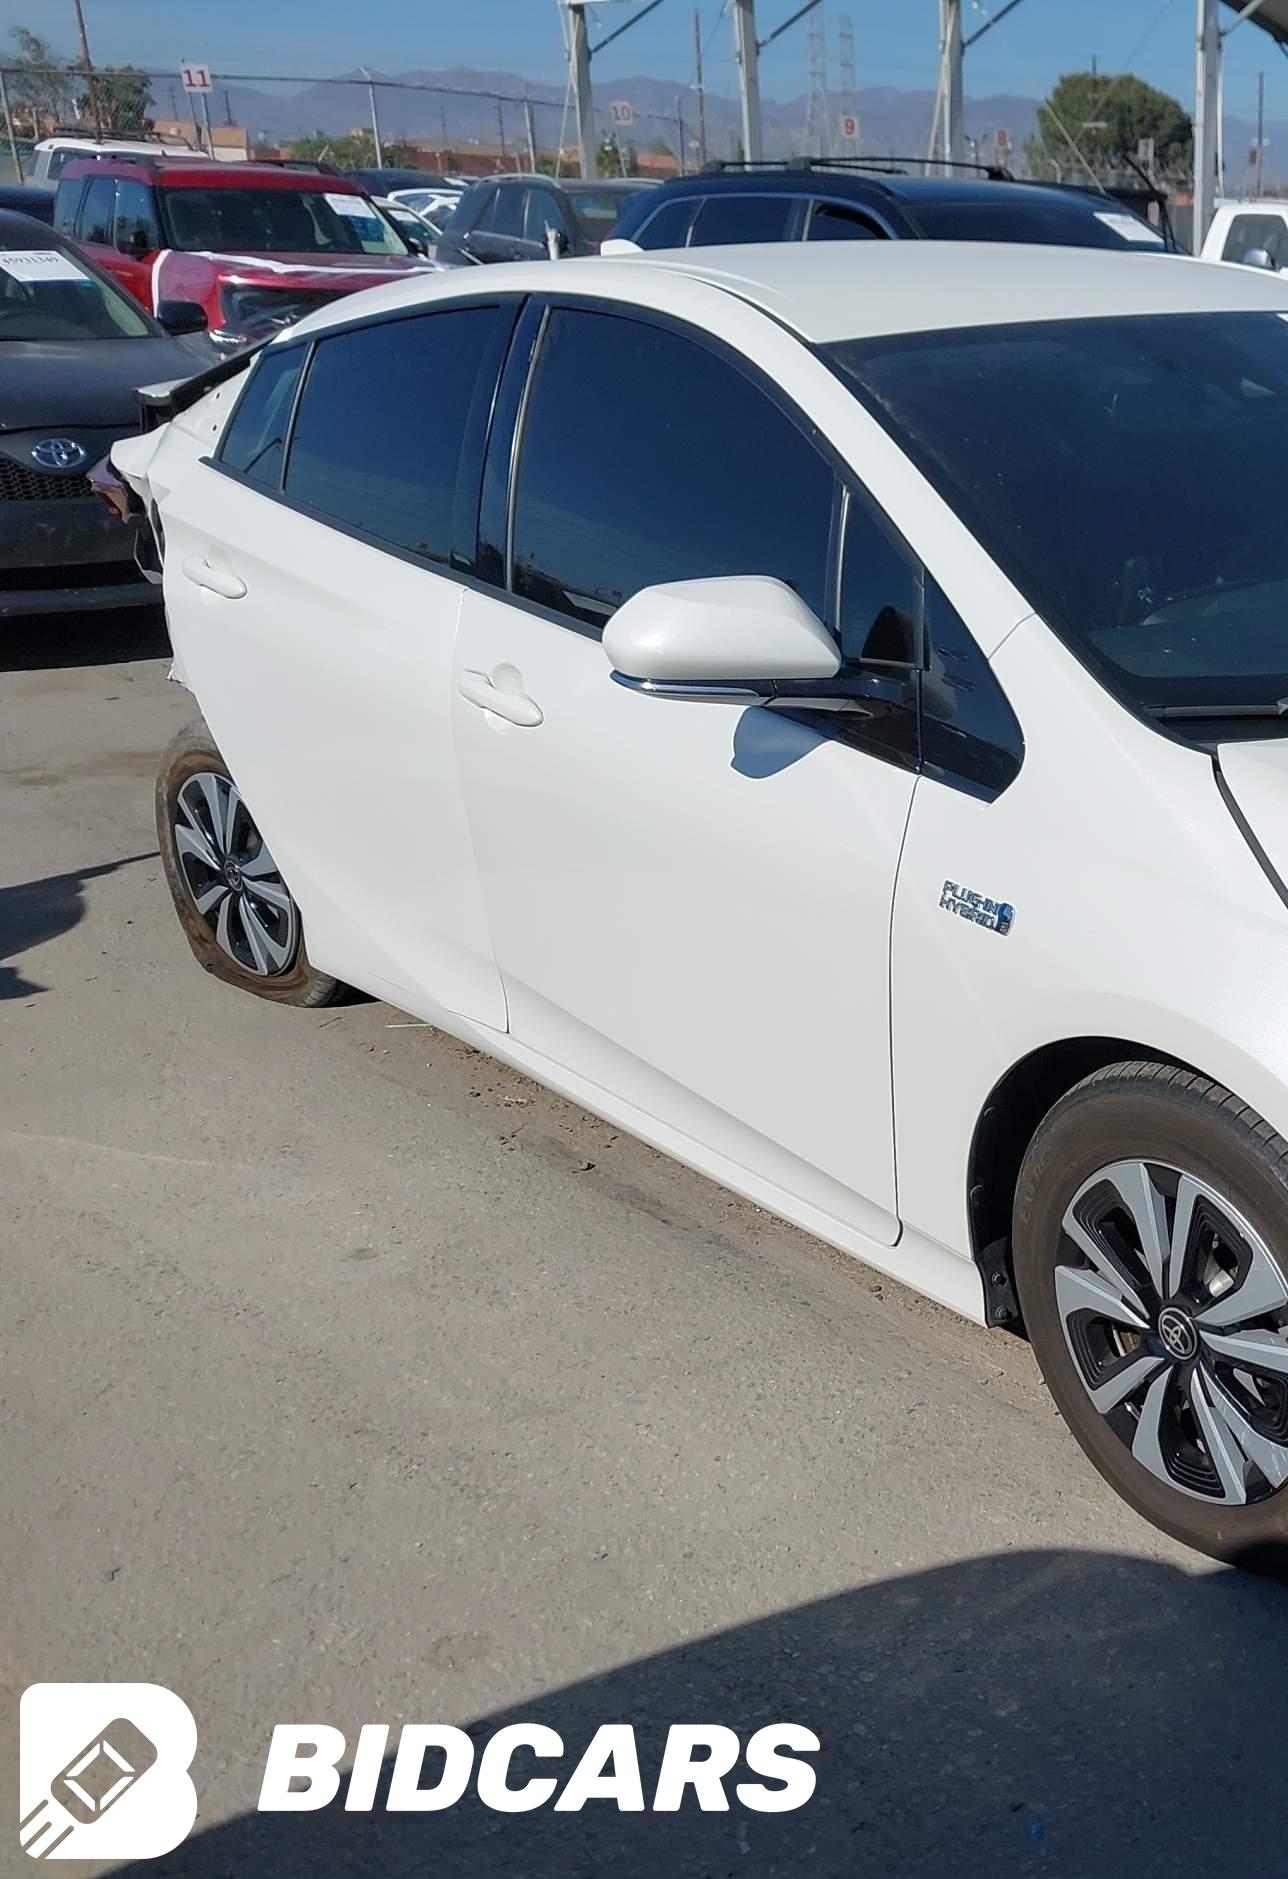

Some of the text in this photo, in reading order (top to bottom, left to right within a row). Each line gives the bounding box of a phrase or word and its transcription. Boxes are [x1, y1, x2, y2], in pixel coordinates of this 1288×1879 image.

[183, 69, 210, 87] 11
[612, 105, 630, 121] 10
[844, 118, 855, 135] 9
[943, 880, 998, 914] PLUG-IN
[939, 894, 999, 931] HYBRID
